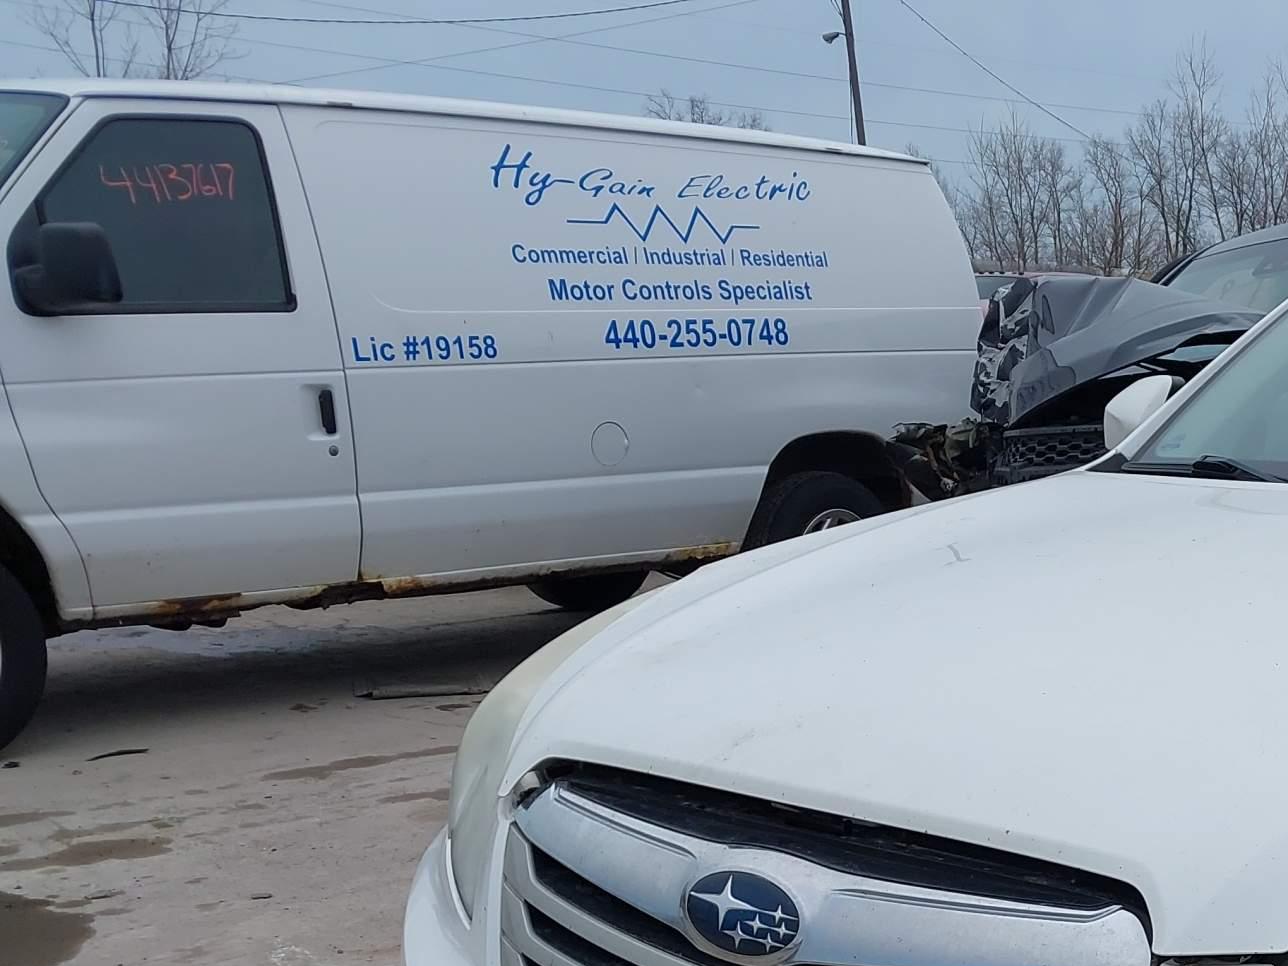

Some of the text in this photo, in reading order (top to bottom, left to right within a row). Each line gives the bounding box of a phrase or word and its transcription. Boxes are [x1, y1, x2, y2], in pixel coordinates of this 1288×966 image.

[489, 143, 811, 206] Hy-Gain Electric
[511, 243, 628, 265] Commercial
[643, 246, 726, 266] Industrial
[739, 248, 829, 268] Residential
[548, 278, 813, 305] Motor Controls Specialist
[605, 318, 789, 350] 440-255-0748
[351, 335, 498, 362] Lic #19158
